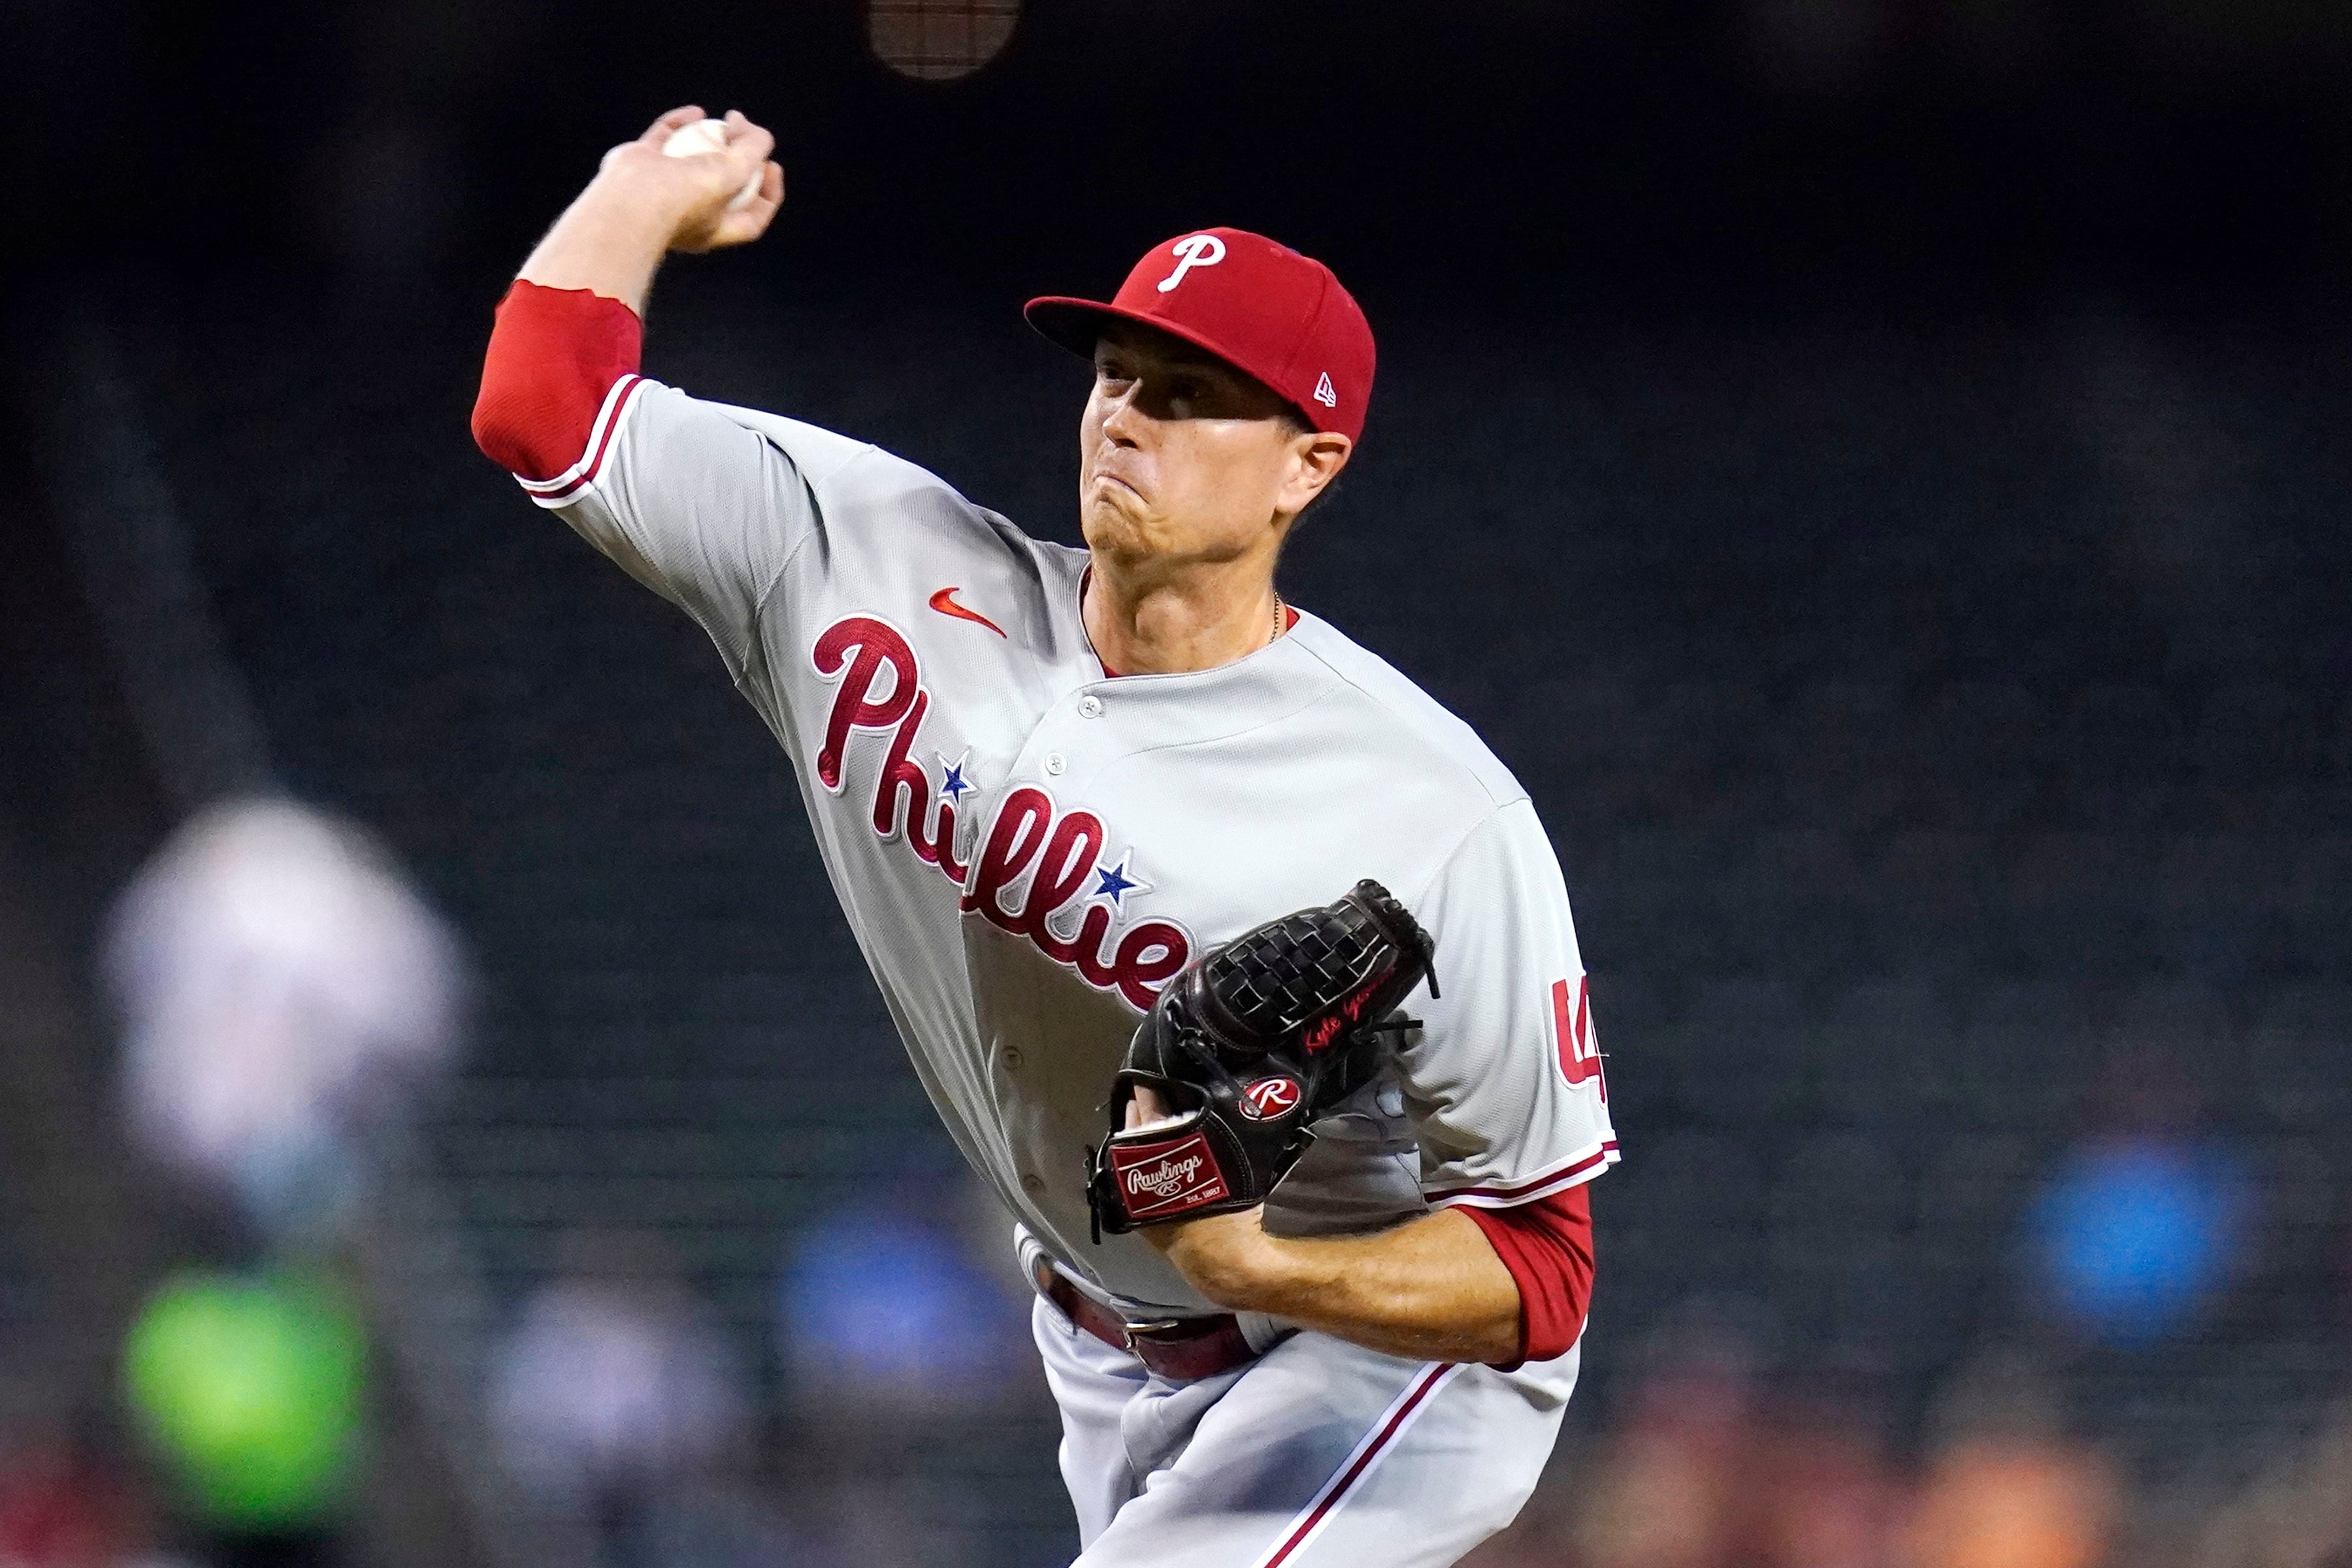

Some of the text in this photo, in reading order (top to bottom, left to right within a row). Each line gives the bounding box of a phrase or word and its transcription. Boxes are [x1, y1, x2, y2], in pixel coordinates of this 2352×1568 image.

[1156, 234, 1226, 293] P
[811, 613, 1197, 1015] Phillie
[1244, 1078, 1294, 1117] R
[1128, 1155, 1203, 1194] Rawlings
